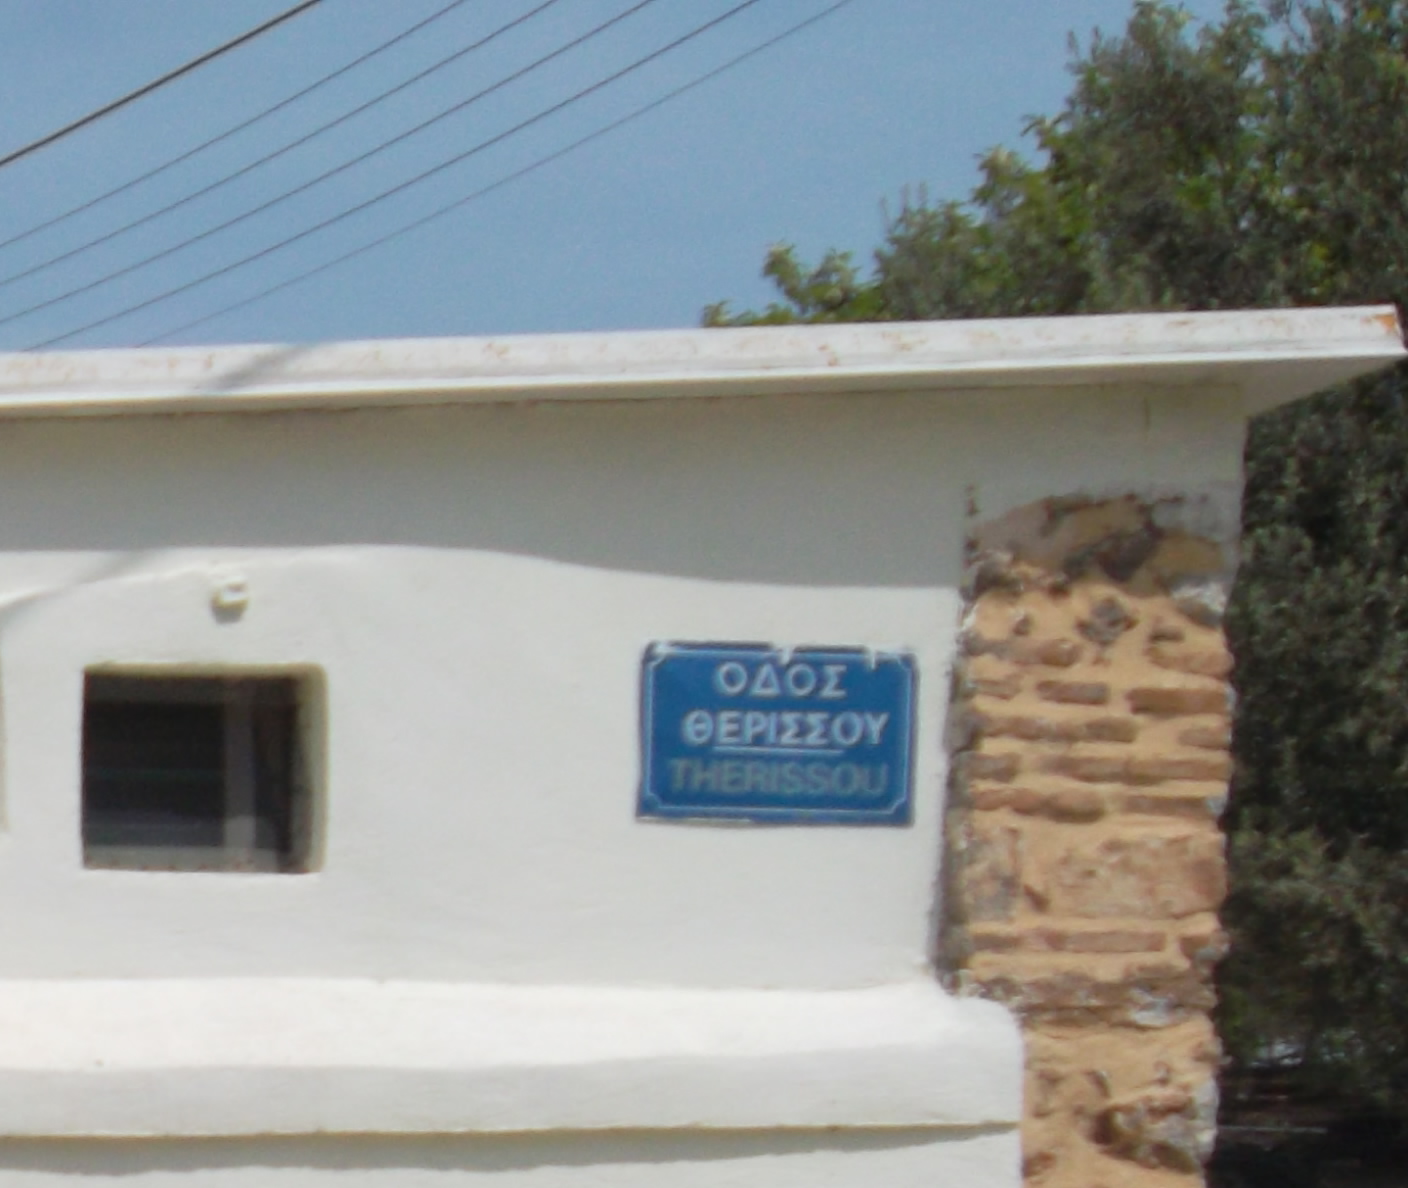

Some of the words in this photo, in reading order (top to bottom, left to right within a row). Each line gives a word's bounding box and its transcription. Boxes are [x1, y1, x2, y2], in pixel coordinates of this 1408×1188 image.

[717, 662, 847, 697] ΟΔΟΣ
[684, 709, 889, 746] ΘΕΡΙΣΣΟΥ
[670, 759, 888, 796] THERISSOU
